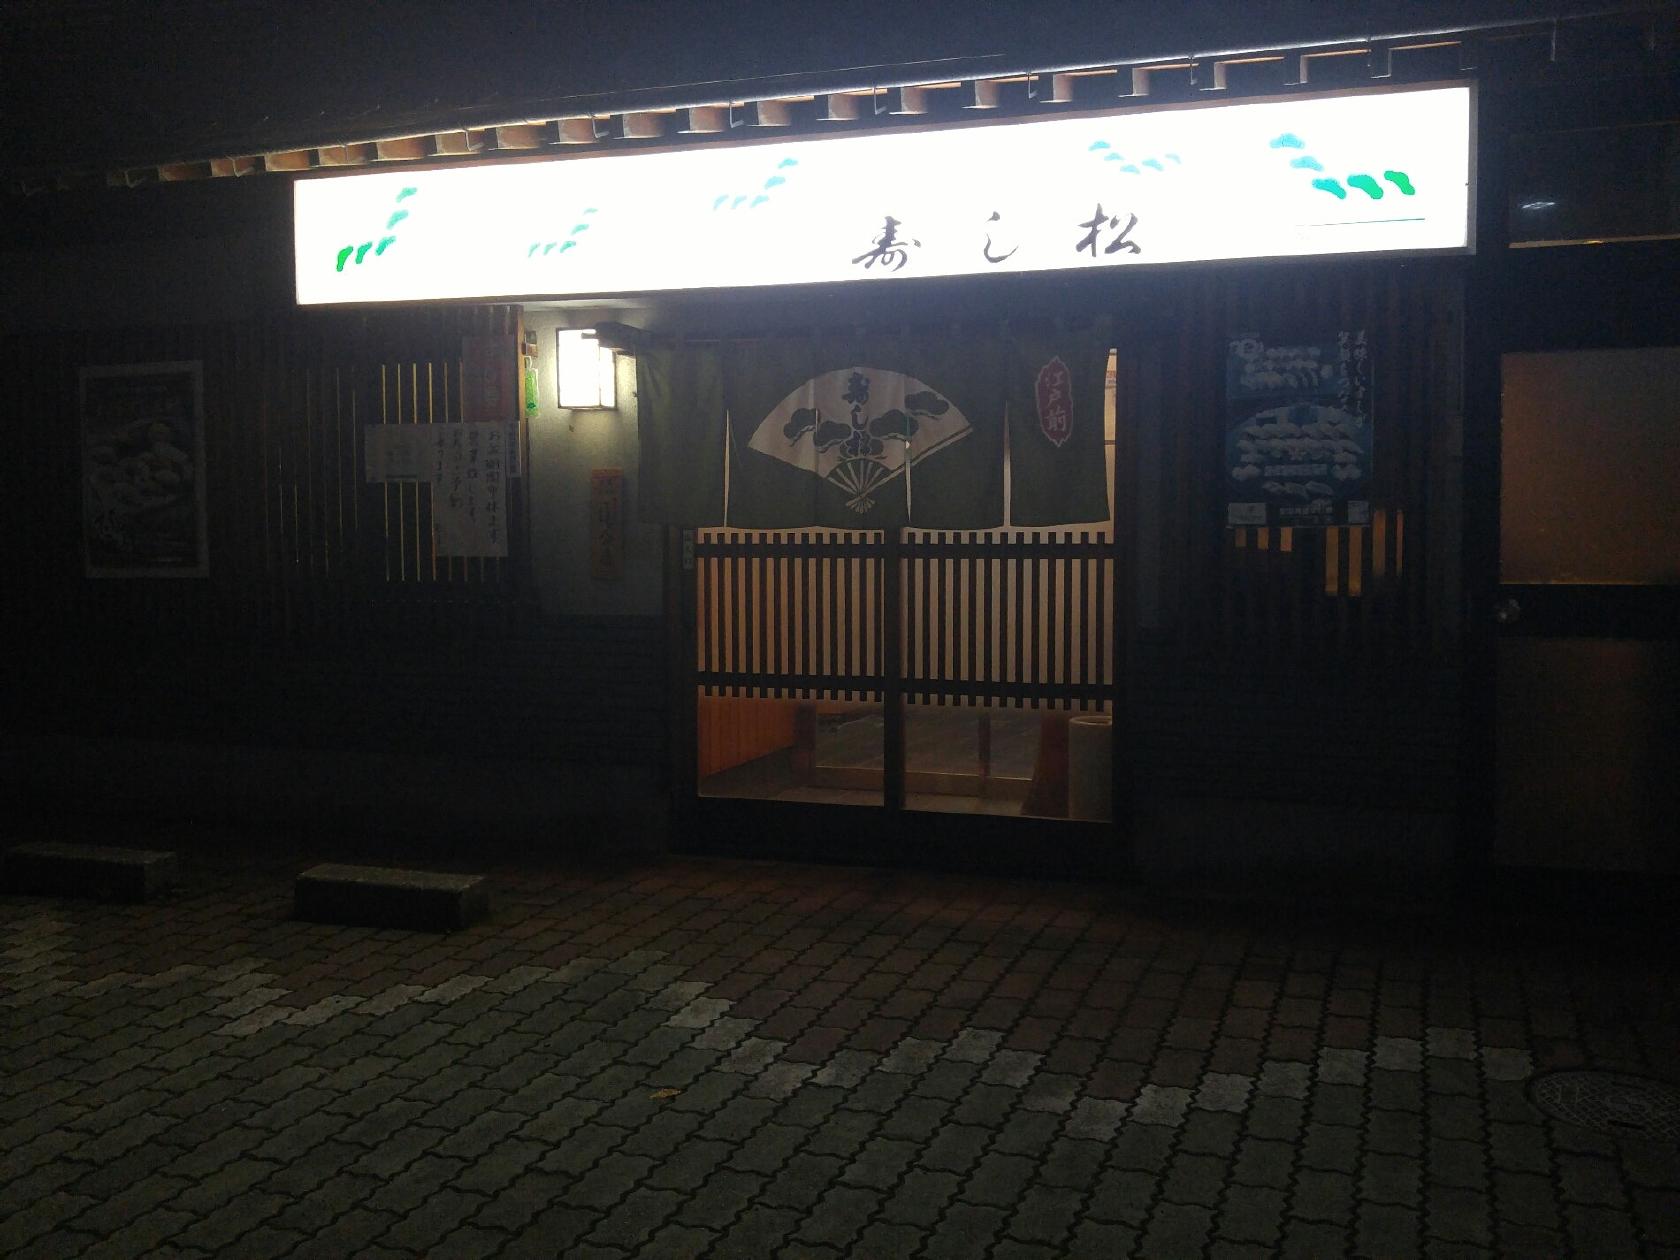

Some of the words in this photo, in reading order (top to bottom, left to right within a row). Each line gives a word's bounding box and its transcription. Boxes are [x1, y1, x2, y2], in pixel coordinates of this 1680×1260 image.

[852, 202, 1142, 272] 寿し松
[1043, 371, 1067, 432] 江戸前
